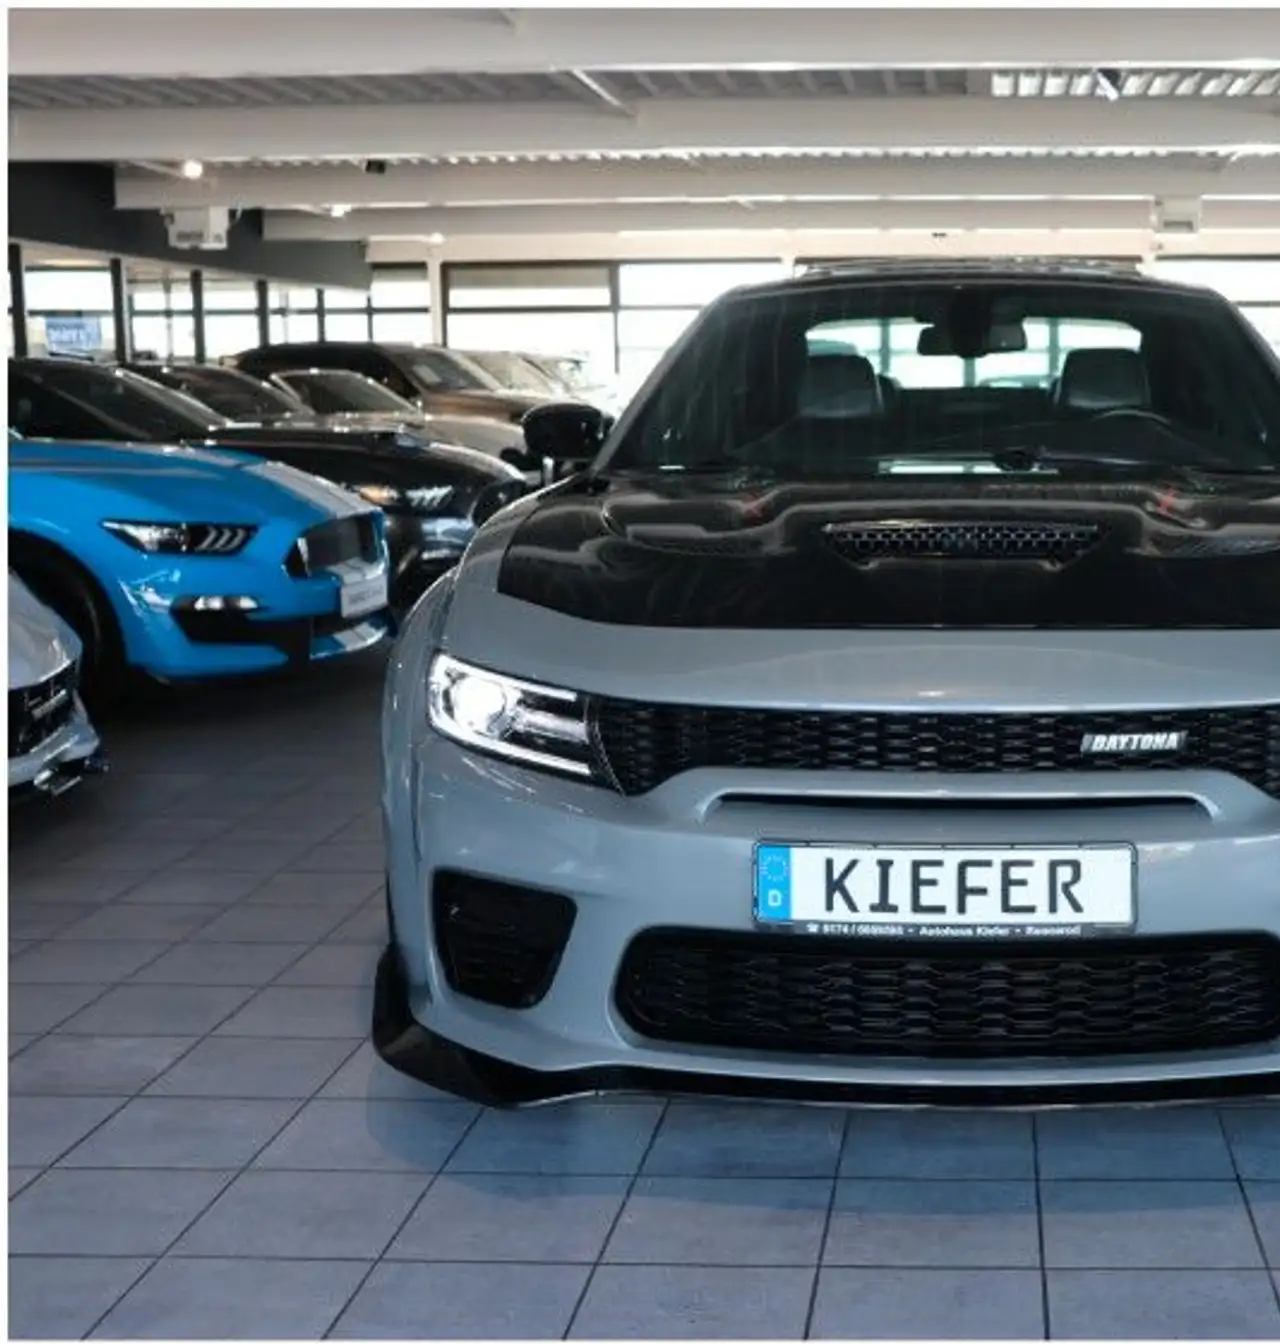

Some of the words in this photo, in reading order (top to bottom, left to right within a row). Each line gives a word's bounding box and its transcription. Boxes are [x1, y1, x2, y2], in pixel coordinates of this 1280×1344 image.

[1091, 731, 1179, 752] DAYTONA
[824, 856, 1085, 915] KIEFER
[767, 889, 783, 908] D
